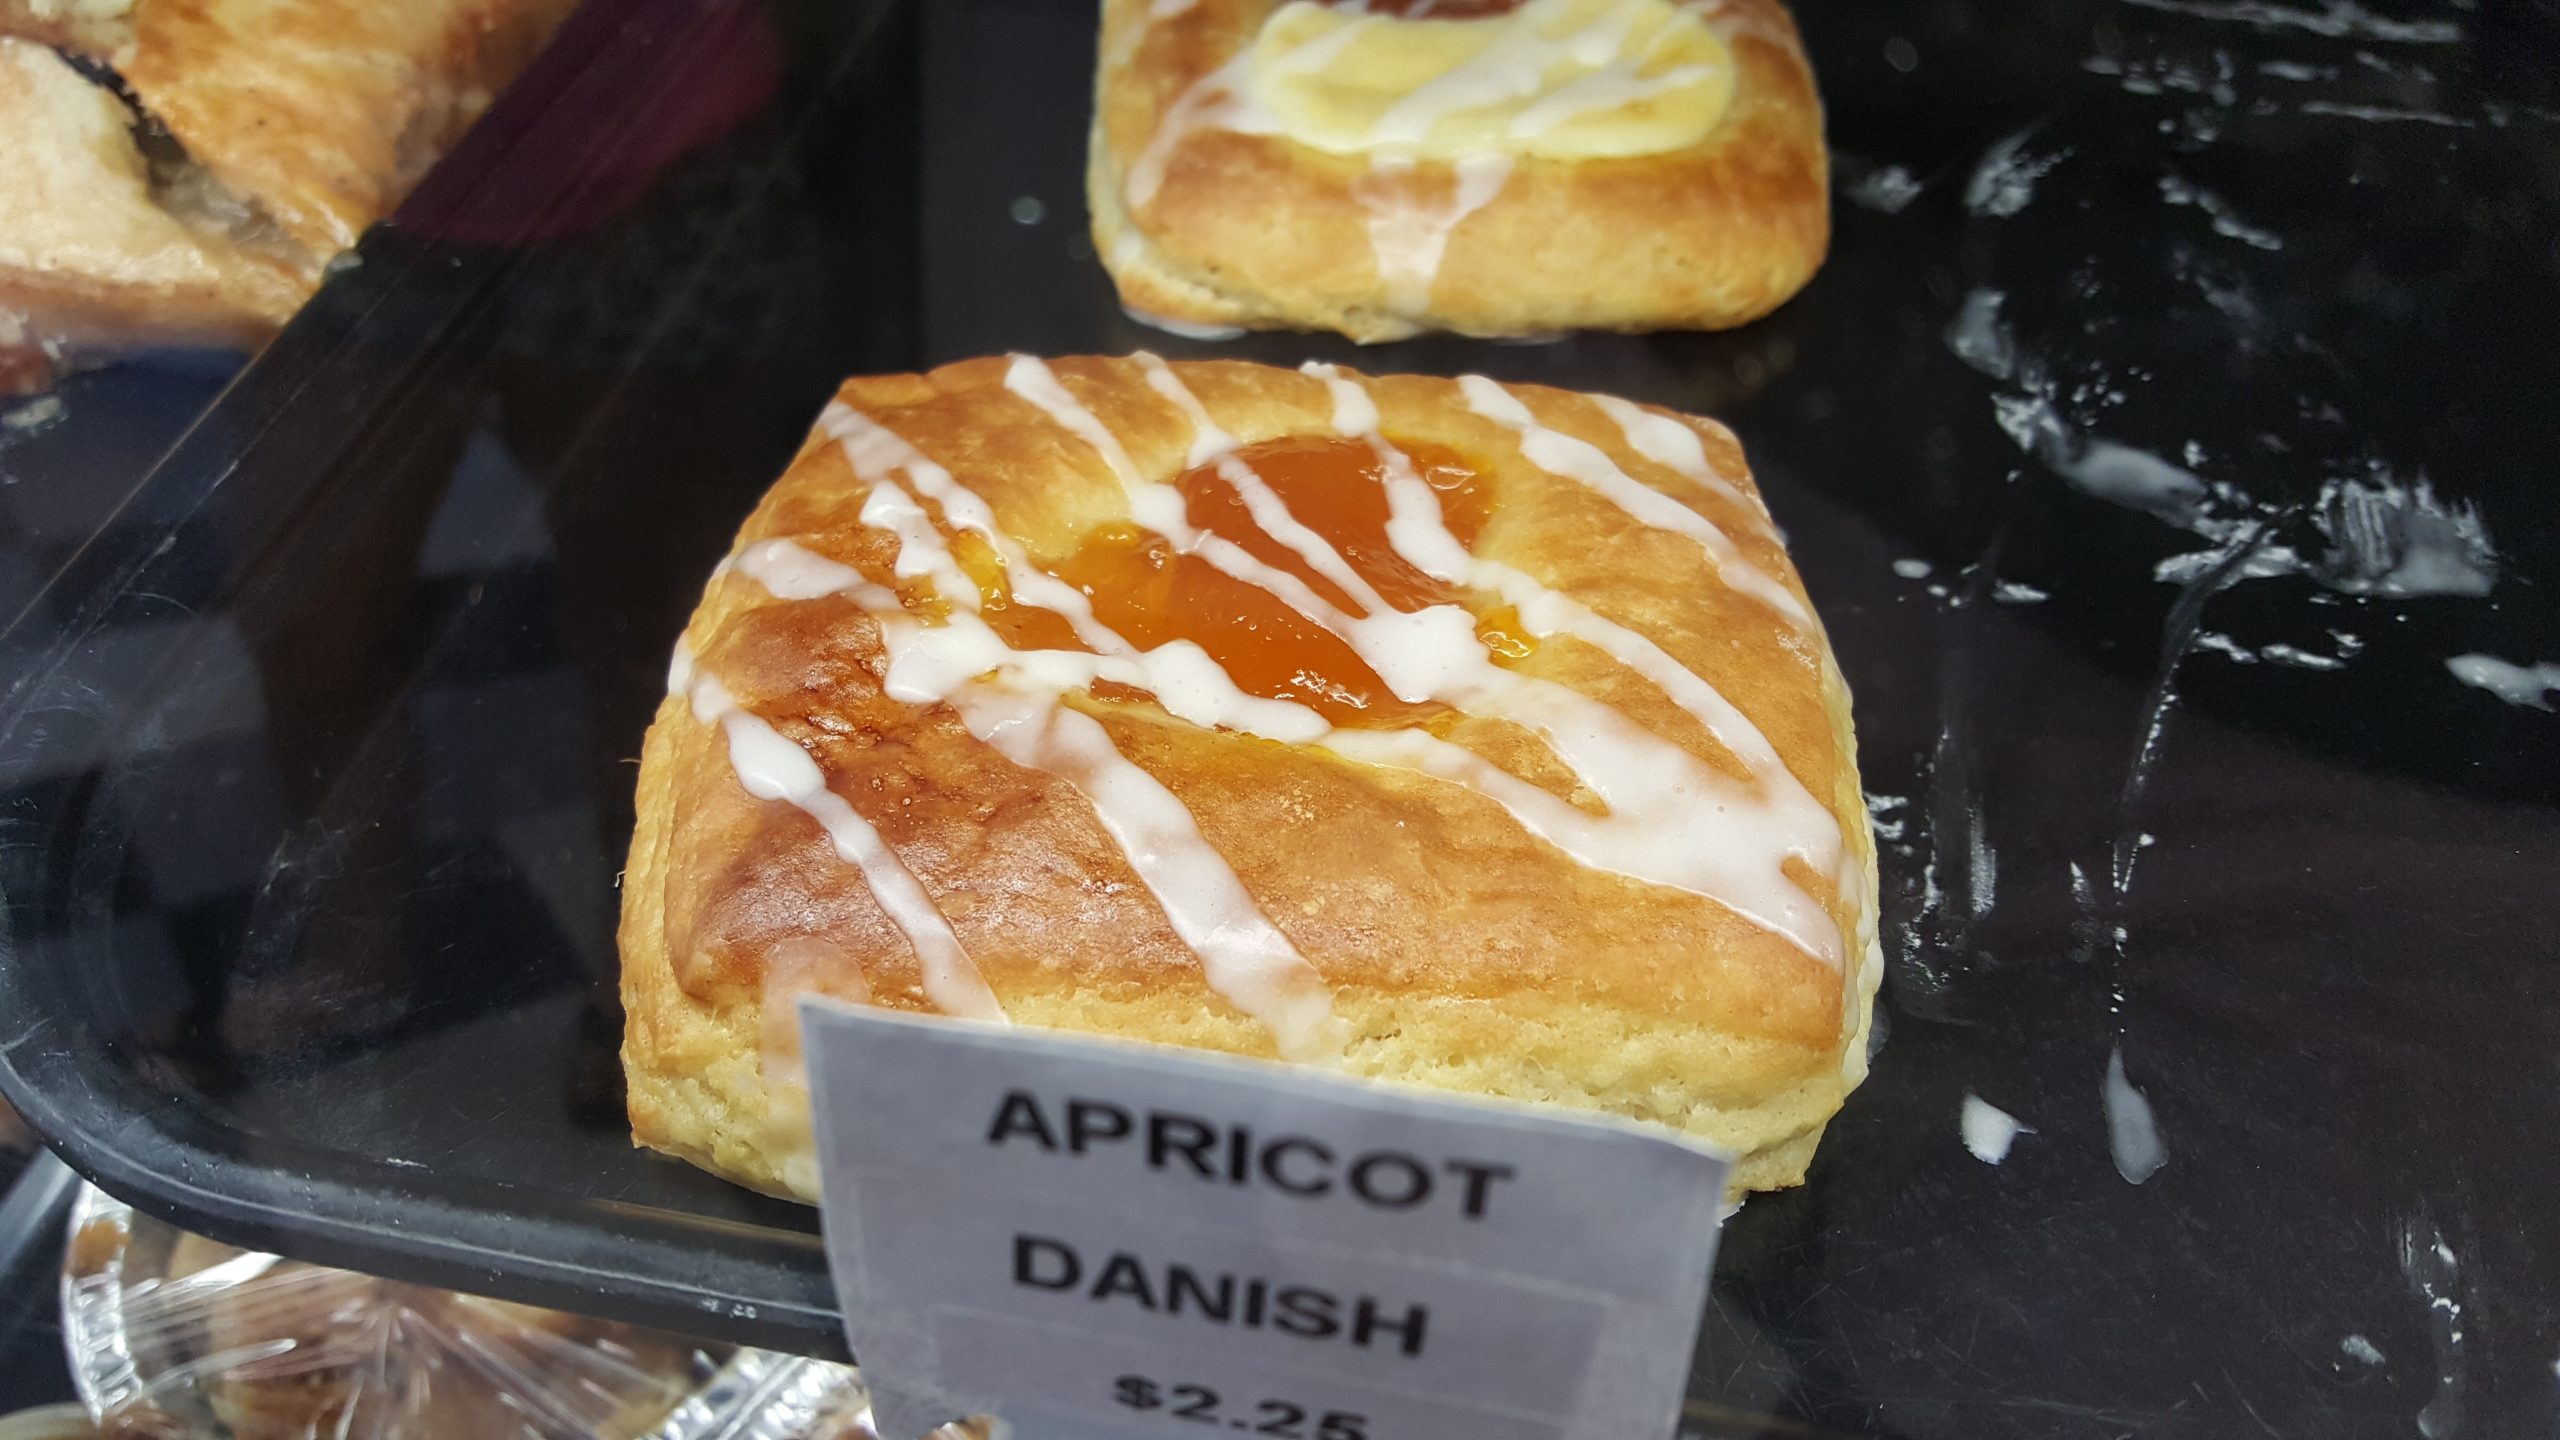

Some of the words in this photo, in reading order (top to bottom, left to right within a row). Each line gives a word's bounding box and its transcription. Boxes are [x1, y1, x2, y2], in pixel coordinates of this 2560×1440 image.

[986, 1088, 1517, 1222] APRICOT
[1011, 1233, 1431, 1360] DANISH
[1113, 1374, 1370, 1440] $2.25
